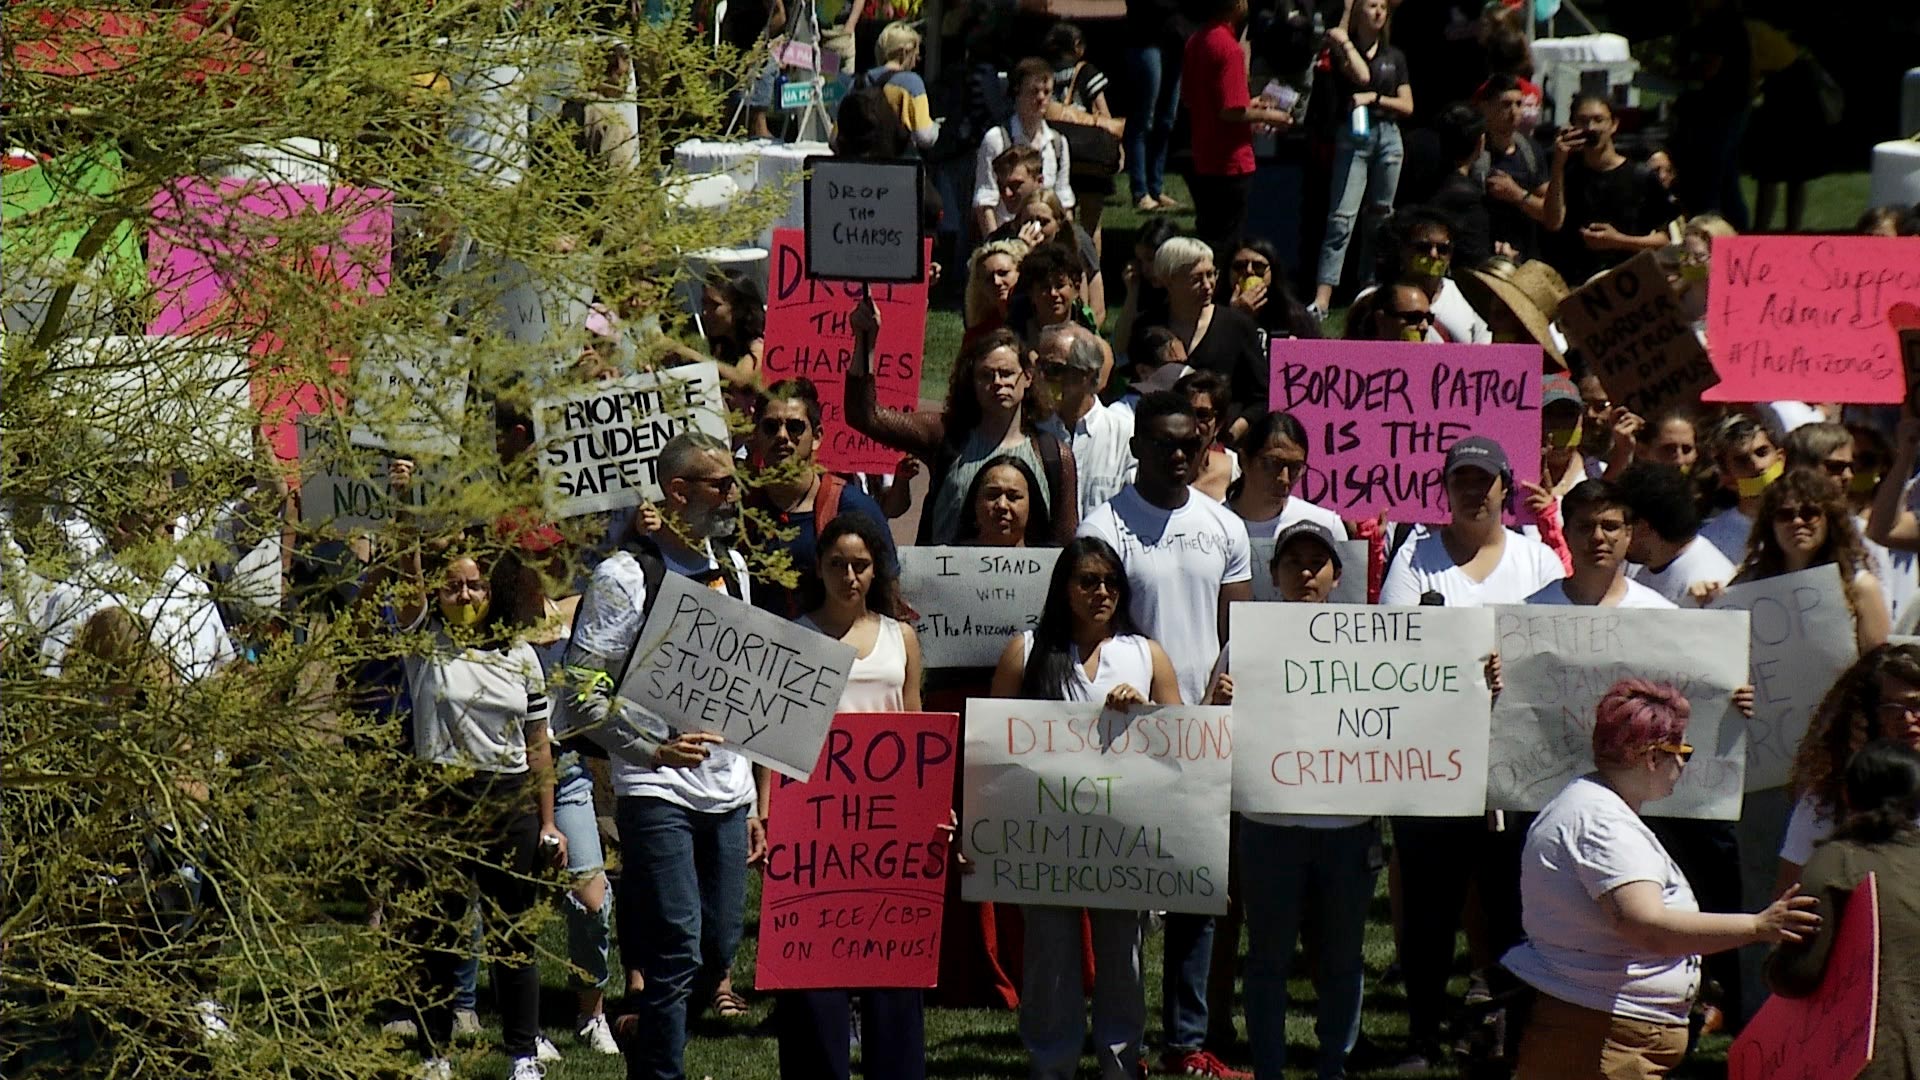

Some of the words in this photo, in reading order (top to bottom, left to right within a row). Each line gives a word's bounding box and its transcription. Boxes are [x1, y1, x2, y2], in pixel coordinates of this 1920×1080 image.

[828, 181, 889, 200] DROP
[1726, 243, 1778, 288] We
[1580, 270, 1639, 321] NO
[810, 310, 853, 336] TH
[766, 345, 914, 381] CHARES
[1278, 361, 1414, 415] BORDER
[1430, 362, 1539, 417] PATROL
[1325, 420, 1361, 456] IS
[1381, 420, 1472, 458] THE
[556, 455, 659, 498] SAFET
[935, 555, 961, 577] I
[977, 555, 1042, 576] STAND
[975, 587, 1016, 601] WITH
[1309, 611, 1422, 644] CREATE
[1499, 612, 1624, 663] BETTER
[653, 641, 808, 724] STUDENT
[1284, 658, 1460, 695] DIALOGUE
[648, 670, 769, 746] SAFETY
[1336, 706, 1400, 740] NOT
[1007, 714, 1233, 761] DISCUSSIONS
[779, 728, 952, 790] ROP
[1270, 747, 1463, 786] CRIMINALS
[806, 794, 897, 831] THE
[1038, 775, 1122, 816] NOT
[971, 818, 1175, 860] CRIMINAL
[766, 839, 945, 889] CHARGES
[993, 858, 1216, 898] REPERCUSSIONS
[774, 911, 799, 932] NO
[782, 941, 812, 960] ON
[832, 932, 937, 960] CAMPUS!
